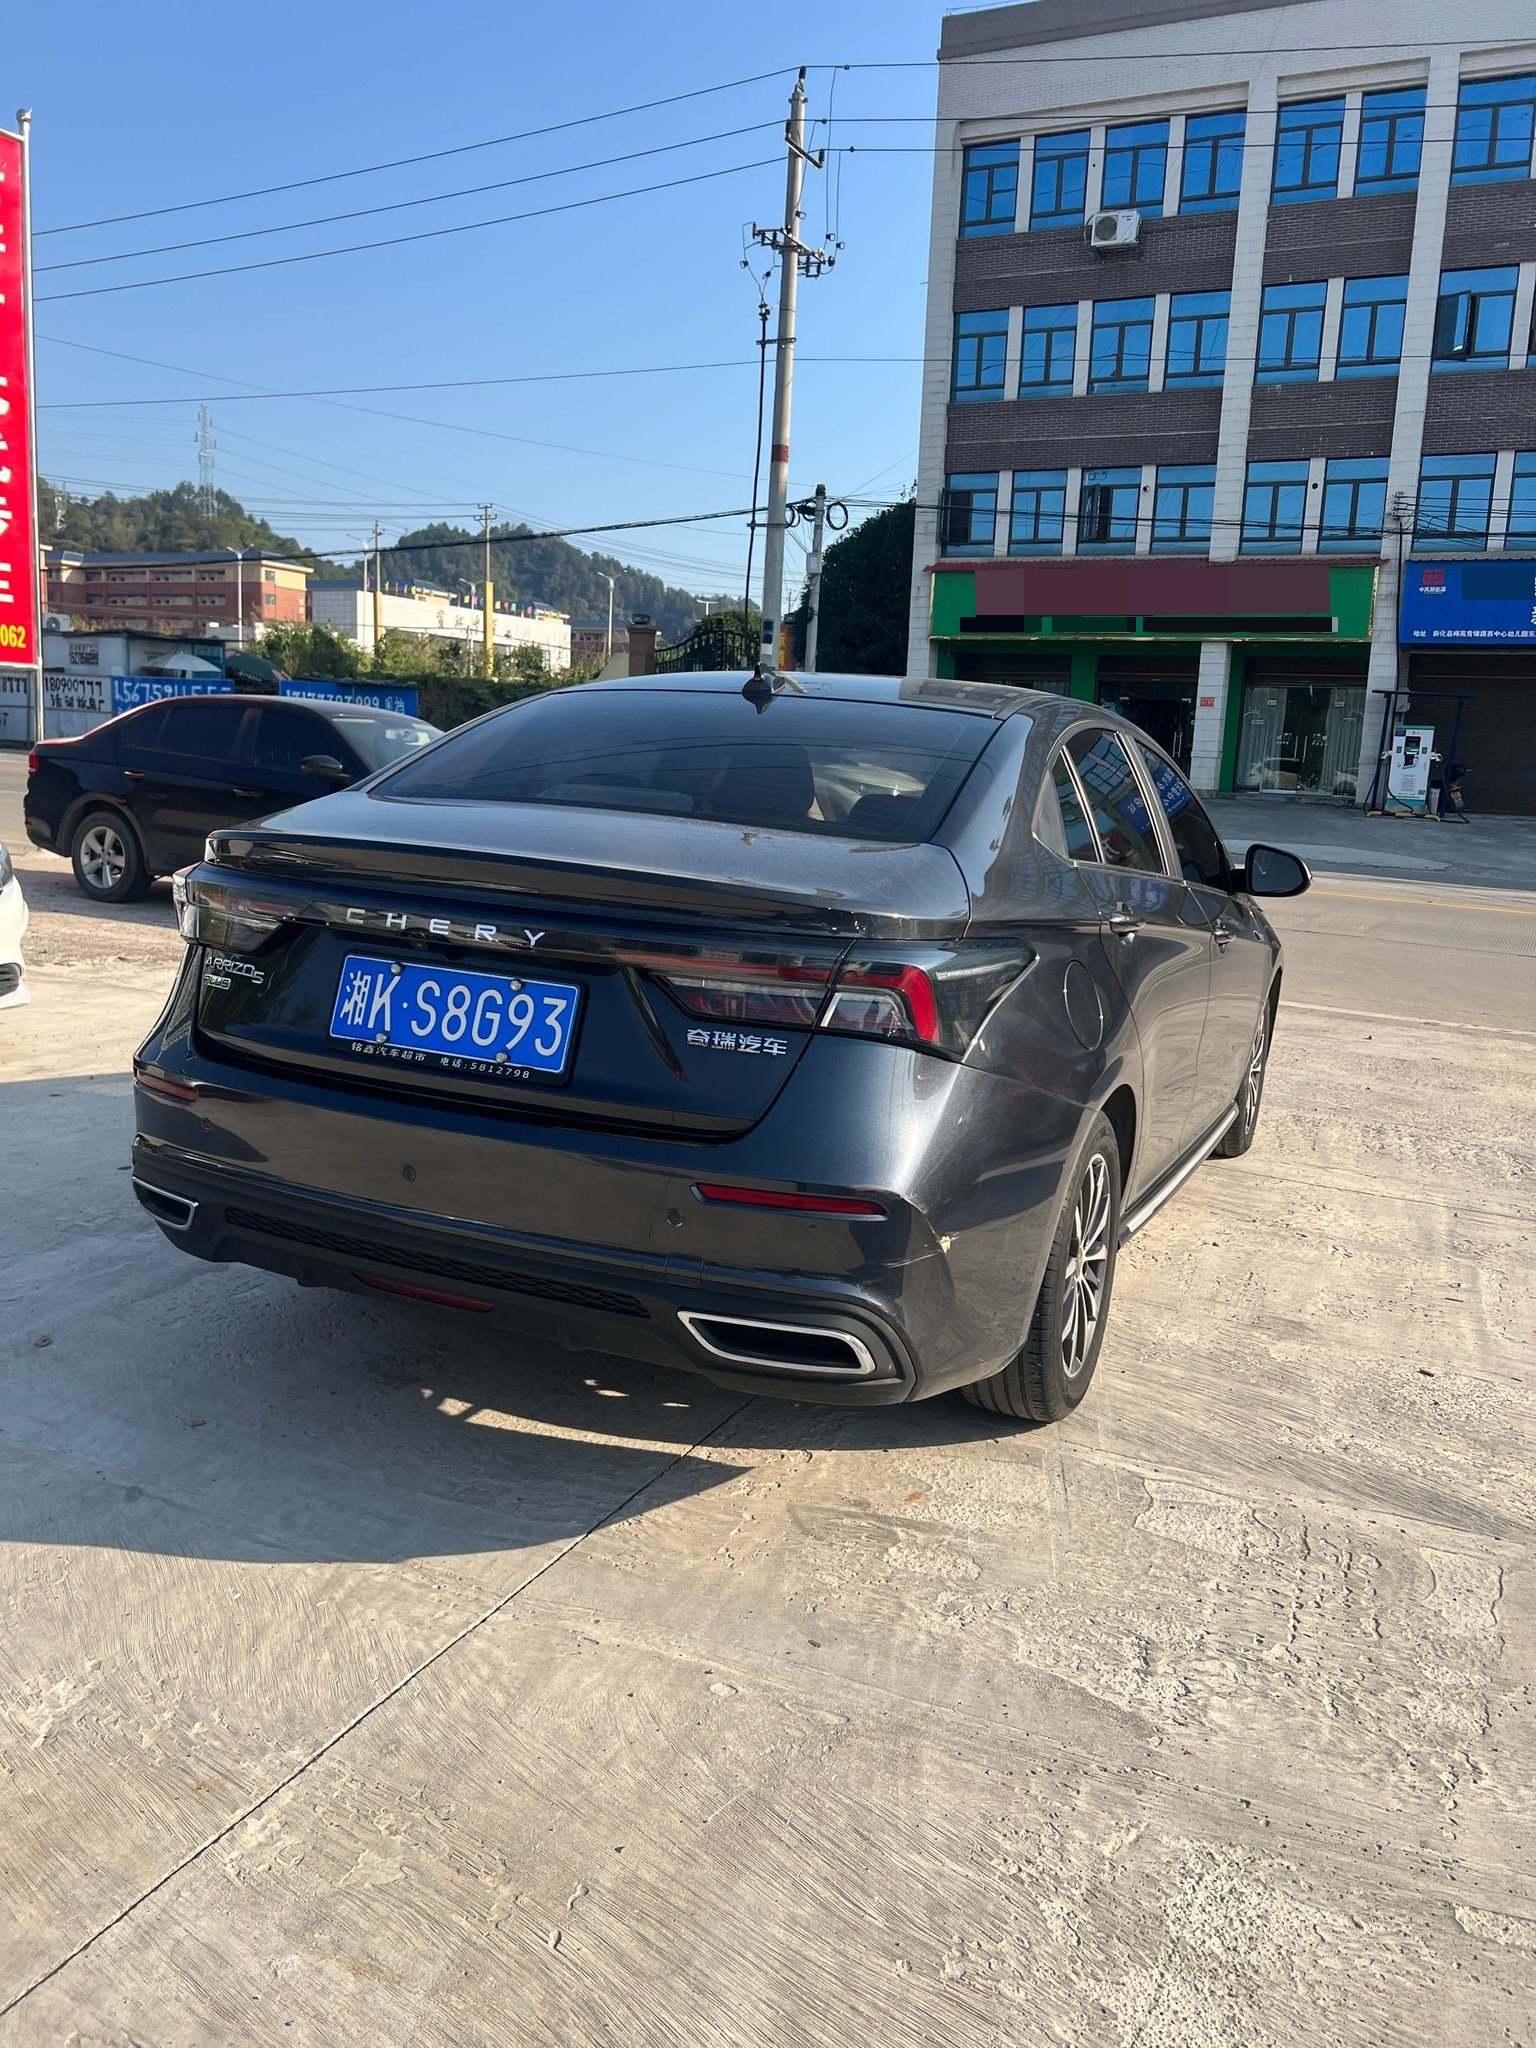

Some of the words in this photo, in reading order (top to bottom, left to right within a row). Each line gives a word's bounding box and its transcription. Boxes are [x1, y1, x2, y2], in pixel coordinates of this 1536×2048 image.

[345, 907, 545, 948] CHERY
[686, 1028, 788, 1056] 奇瑞汽车
